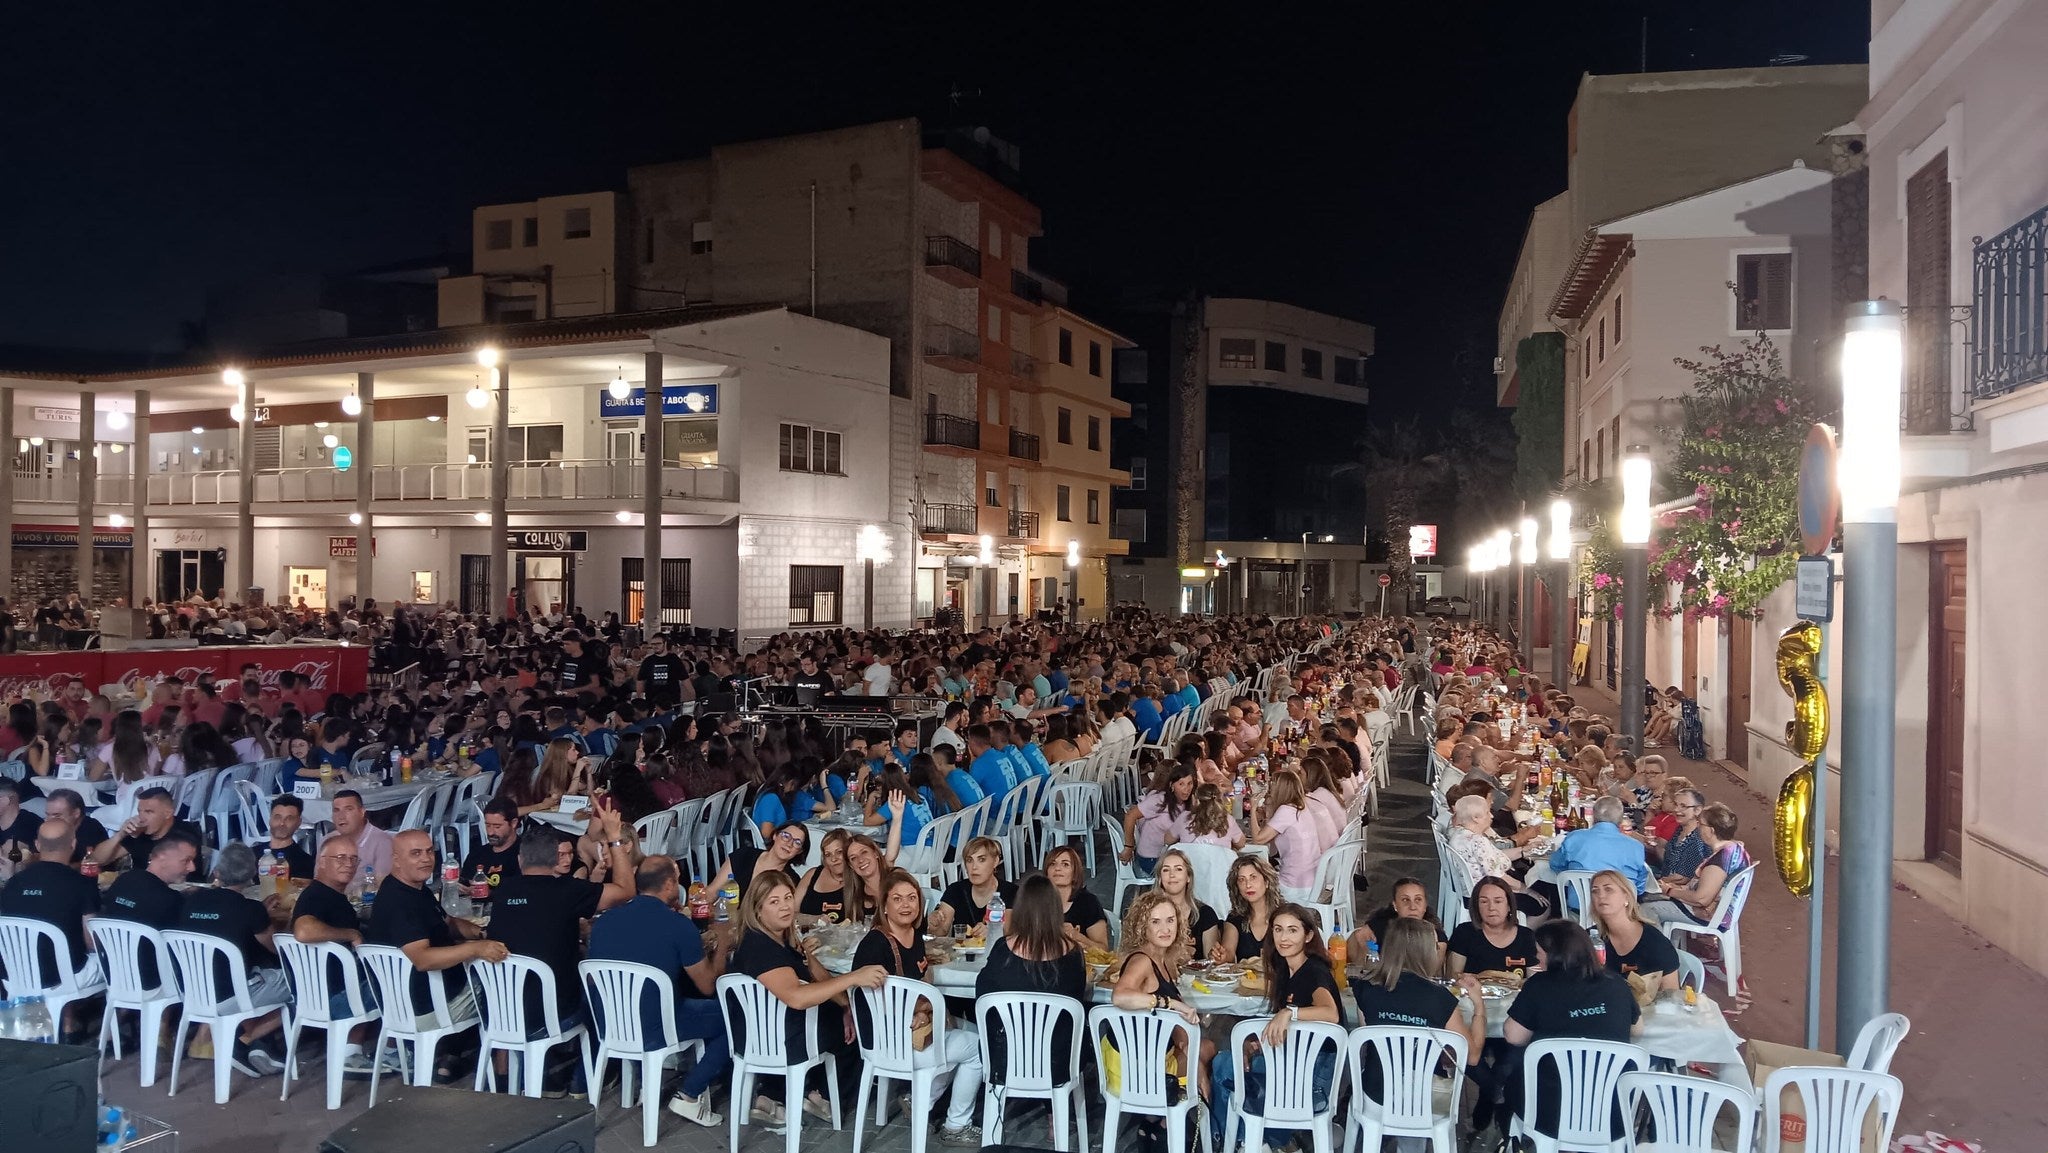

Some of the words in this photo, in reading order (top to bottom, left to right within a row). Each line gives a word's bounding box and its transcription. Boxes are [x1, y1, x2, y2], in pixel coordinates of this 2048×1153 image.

[525, 532, 564, 551] COLAUS
[295, 785, 316, 795] 2007
[190, 912, 220, 920] JUANJO
